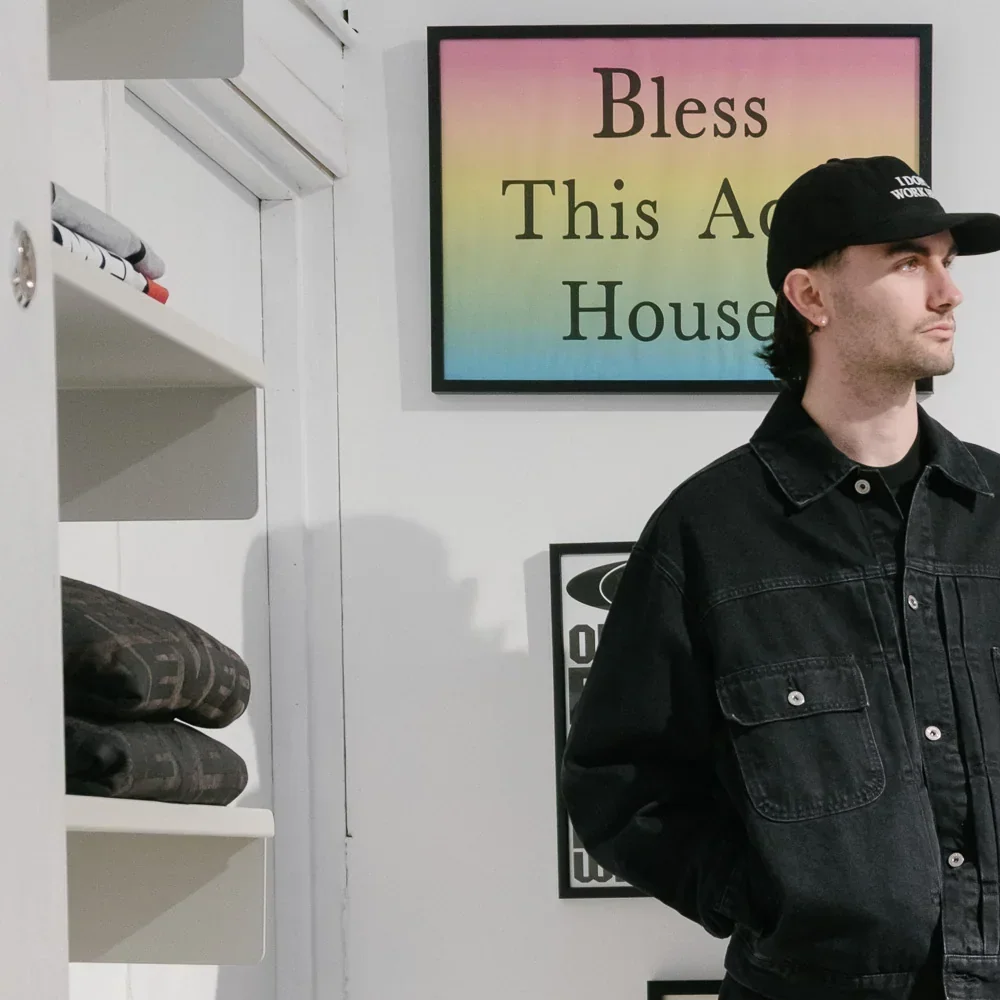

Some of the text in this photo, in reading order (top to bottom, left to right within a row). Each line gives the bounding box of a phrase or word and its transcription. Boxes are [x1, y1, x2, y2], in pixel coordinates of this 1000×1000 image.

[593, 67, 768, 139] Bless
[502, 178, 659, 241] This
[894, 176, 906, 186] I
[562, 280, 775, 342] House
